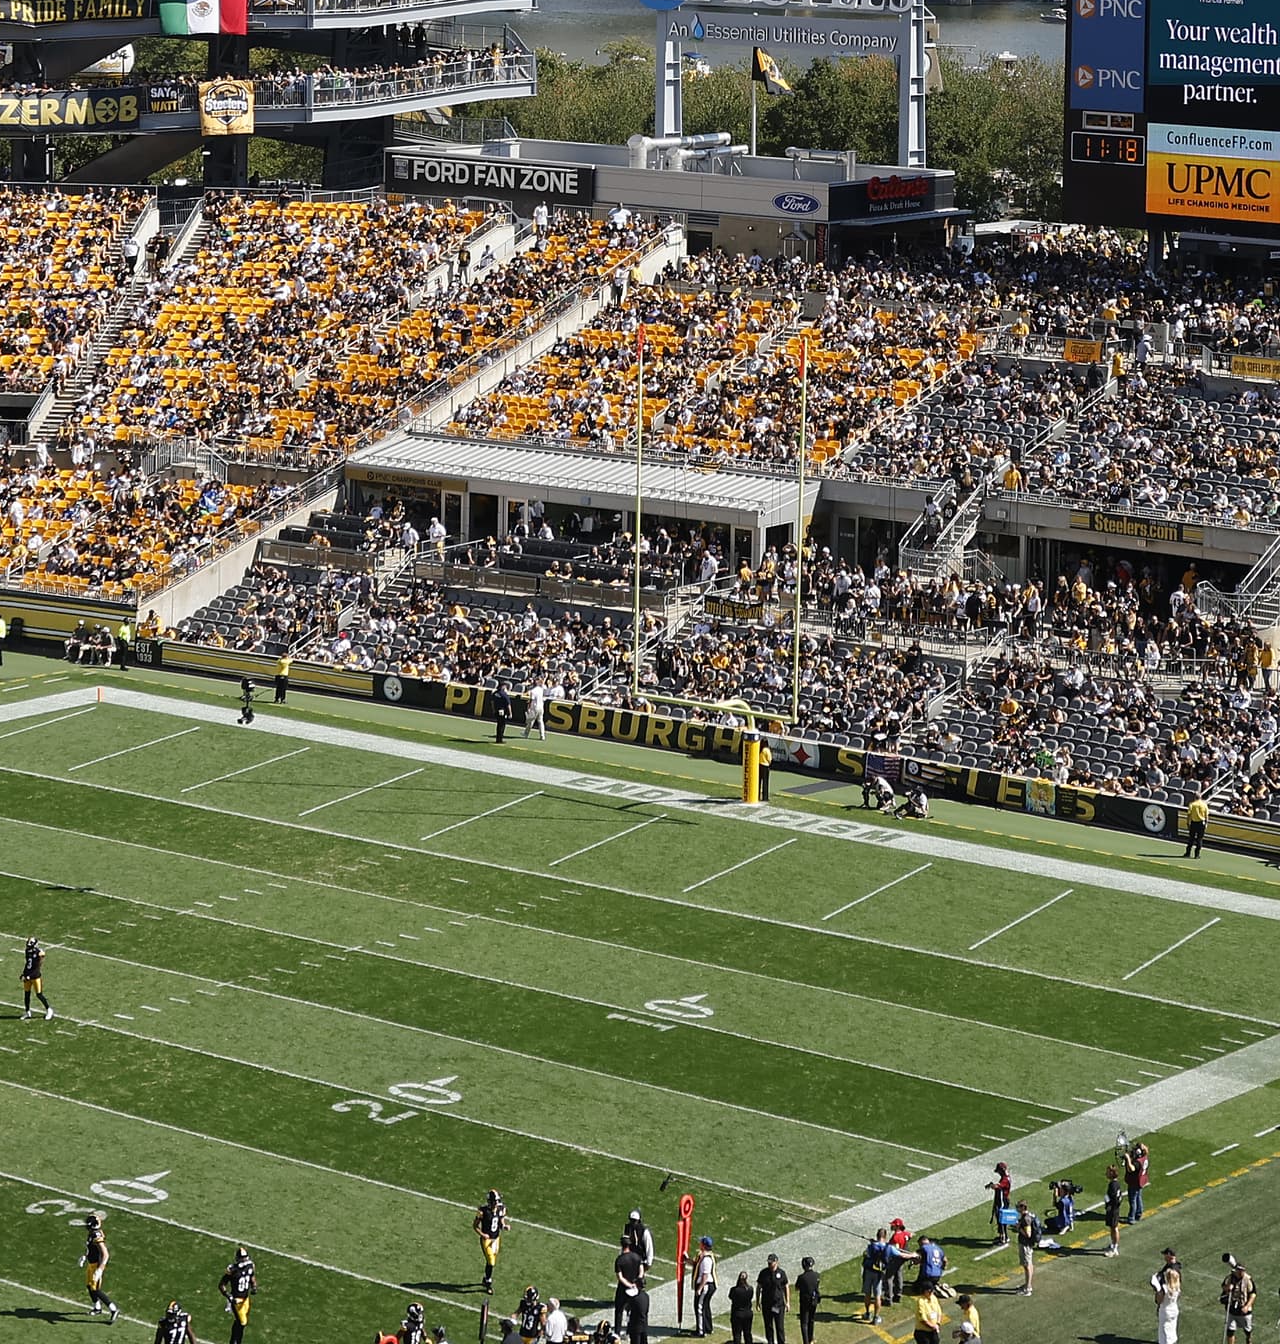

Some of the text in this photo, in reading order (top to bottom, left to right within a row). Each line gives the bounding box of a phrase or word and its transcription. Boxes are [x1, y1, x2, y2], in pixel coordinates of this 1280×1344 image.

[669, 22, 897, 54] An Essential Utilities Company
[1166, 19, 1278, 46] Your wealth
[1097, 69, 1141, 90] PNC
[205, 98, 248, 111] Steelers
[1182, 82, 1258, 109] partner.
[1081, 136, 1138, 163] 11:18
[1166, 130, 1273, 153] ConfluenceFP.com
[413, 159, 470, 185] FORD
[474, 163, 516, 189] FAN
[519, 168, 579, 195] ZONE
[1166, 162, 1271, 200] UPMC
[781, 195, 812, 213] Ford
[904, 199, 921, 209] House
[1168, 198, 1271, 214] LIFE CHANGING MEDICINE
[1094, 513, 1178, 542] Steelers.com
[136, 644, 153, 655] EST.
[445, 683, 743, 754] PISBURGH
[562, 775, 668, 801] END
